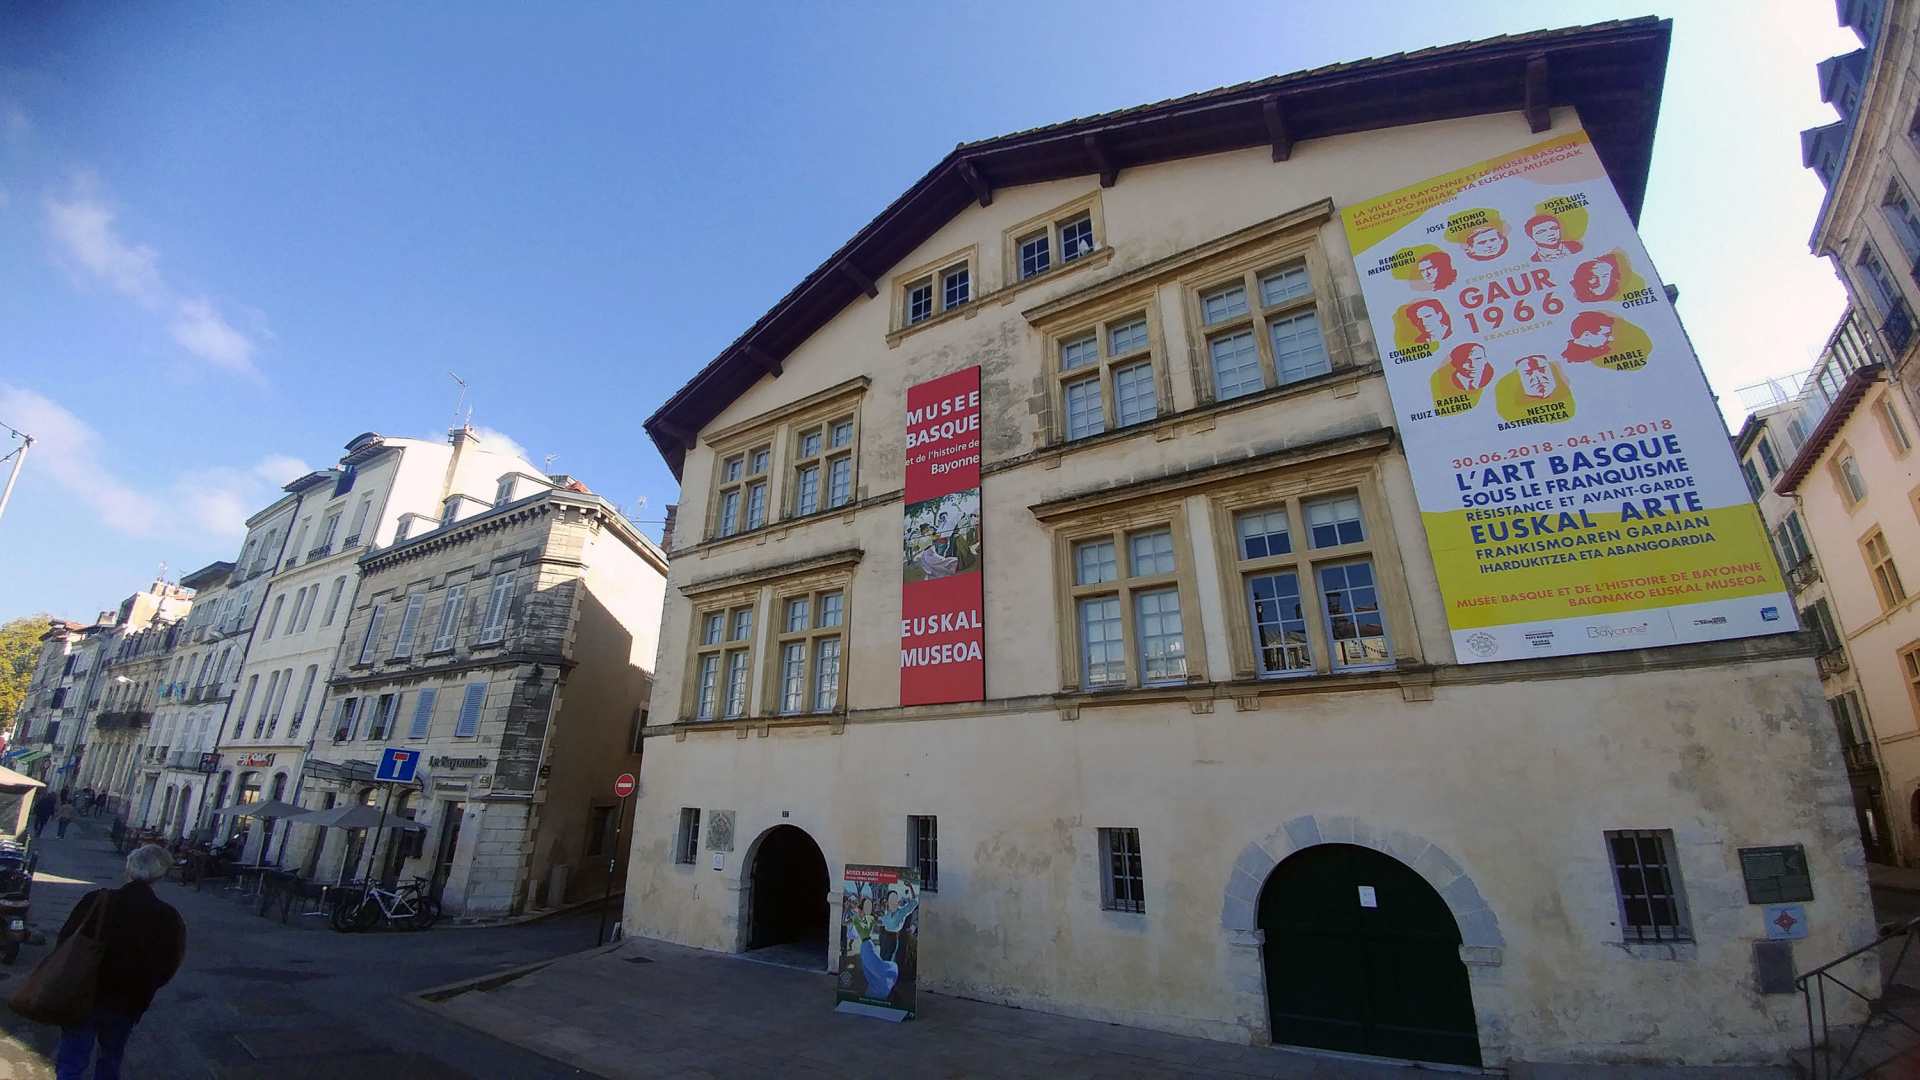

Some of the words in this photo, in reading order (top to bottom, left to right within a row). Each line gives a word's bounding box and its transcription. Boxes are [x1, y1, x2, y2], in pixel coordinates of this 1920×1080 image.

[1353, 210, 1365, 219] LA
[1367, 200, 1393, 213] VILLE
[1394, 196, 1407, 205] DE
[1410, 177, 1463, 199] BAYONNE
[1465, 173, 1477, 182] ET
[1479, 169, 1491, 177] LE
[1531, 141, 1579, 160] BASQUE
[1355, 202, 1414, 226] BAIONAKO
[1416, 190, 1454, 207] HIRIAK
[1457, 183, 1477, 193] ETA
[1478, 167, 1521, 186] EUSKAL
[1523, 149, 1583, 172] MUSEOAK
[1543, 198, 1565, 210] JOSE
[1565, 192, 1586, 203] LUIS
[1552, 199, 1589, 215] ZUMETA
[1425, 223, 1446, 235] JOSE
[1447, 210, 1486, 228] ANTONIO
[1449, 217, 1489, 234] SISTIAGA
[1367, 257, 1416, 276] MENDIBURU
[1378, 250, 1414, 266] REMIGIO
[1465, 262, 1530, 285] EXPOSITION
[1458, 268, 1557, 309] GAUR
[1622, 286, 1654, 301] JORGE
[1463, 291, 1564, 334] 1966
[1622, 295, 1658, 309] OTEIZA
[1483, 319, 1554, 341] ERAKUSKETA
[1388, 343, 1430, 360] EDUARDO
[1394, 350, 1433, 365] CHILLIDA
[1603, 349, 1644, 365] AMABLE
[1616, 357, 1647, 371] ARIAS
[906, 390, 979, 427] MUSEE
[1410, 409, 1433, 422] RUIZ
[1434, 401, 1473, 417] BALERDI
[1436, 393, 1471, 408] RAFAEL
[1526, 401, 1566, 417] NESTOR
[905, 413, 979, 450] BASQUE
[1497, 410, 1570, 432] BASTERRETXEA
[905, 457, 914, 467] et
[915, 454, 926, 463] de
[928, 443, 967, 460] l'histoire
[968, 439, 979, 449] de
[1451, 441, 1553, 470] 30.06.2018
[1566, 419, 1673, 448] 04.11.2018
[931, 454, 979, 475] Bayonne
[1455, 460, 1536, 491] L'ART
[1548, 433, 1682, 475] BASQUE
[1461, 487, 1517, 508] SOUS
[1520, 482, 1542, 499] LE
[1545, 457, 1689, 494] FRANQUISME
[1465, 499, 1554, 522] RÉSISTANCE
[1558, 495, 1575, 508] ET
[1582, 476, 1696, 504] AVANT-GARDE
[1470, 508, 1598, 545] EUSKAL
[1620, 490, 1703, 523] ARTE
[1475, 529, 1621, 560] FRANKISMOAREN
[1626, 515, 1710, 538] GARAIAN
[1479, 552, 1578, 574] IHARDUKITZEA
[1579, 548, 1604, 561] ETA
[1606, 532, 1716, 557] ABANGOARDIA
[1456, 594, 1498, 609] MUSÉE
[1500, 589, 1554, 604] BASQUE
[1557, 586, 1571, 597] ET
[1574, 584, 1592, 594] DE
[1595, 574, 1668, 592] L'HISTOIRE
[1670, 571, 1689, 582] DE
[1692, 561, 1763, 580] BAYONNE
[1568, 590, 1646, 607] BAIONAKO
[1649, 582, 1703, 598] EUSKAL
[1705, 574, 1768, 591] MUSEOA
[901, 609, 982, 638] EUSKAL
[1586, 625, 1646, 639] Bayonne
[900, 641, 982, 668] MUSEOA
[441, 754, 489, 771] Bayonnais
